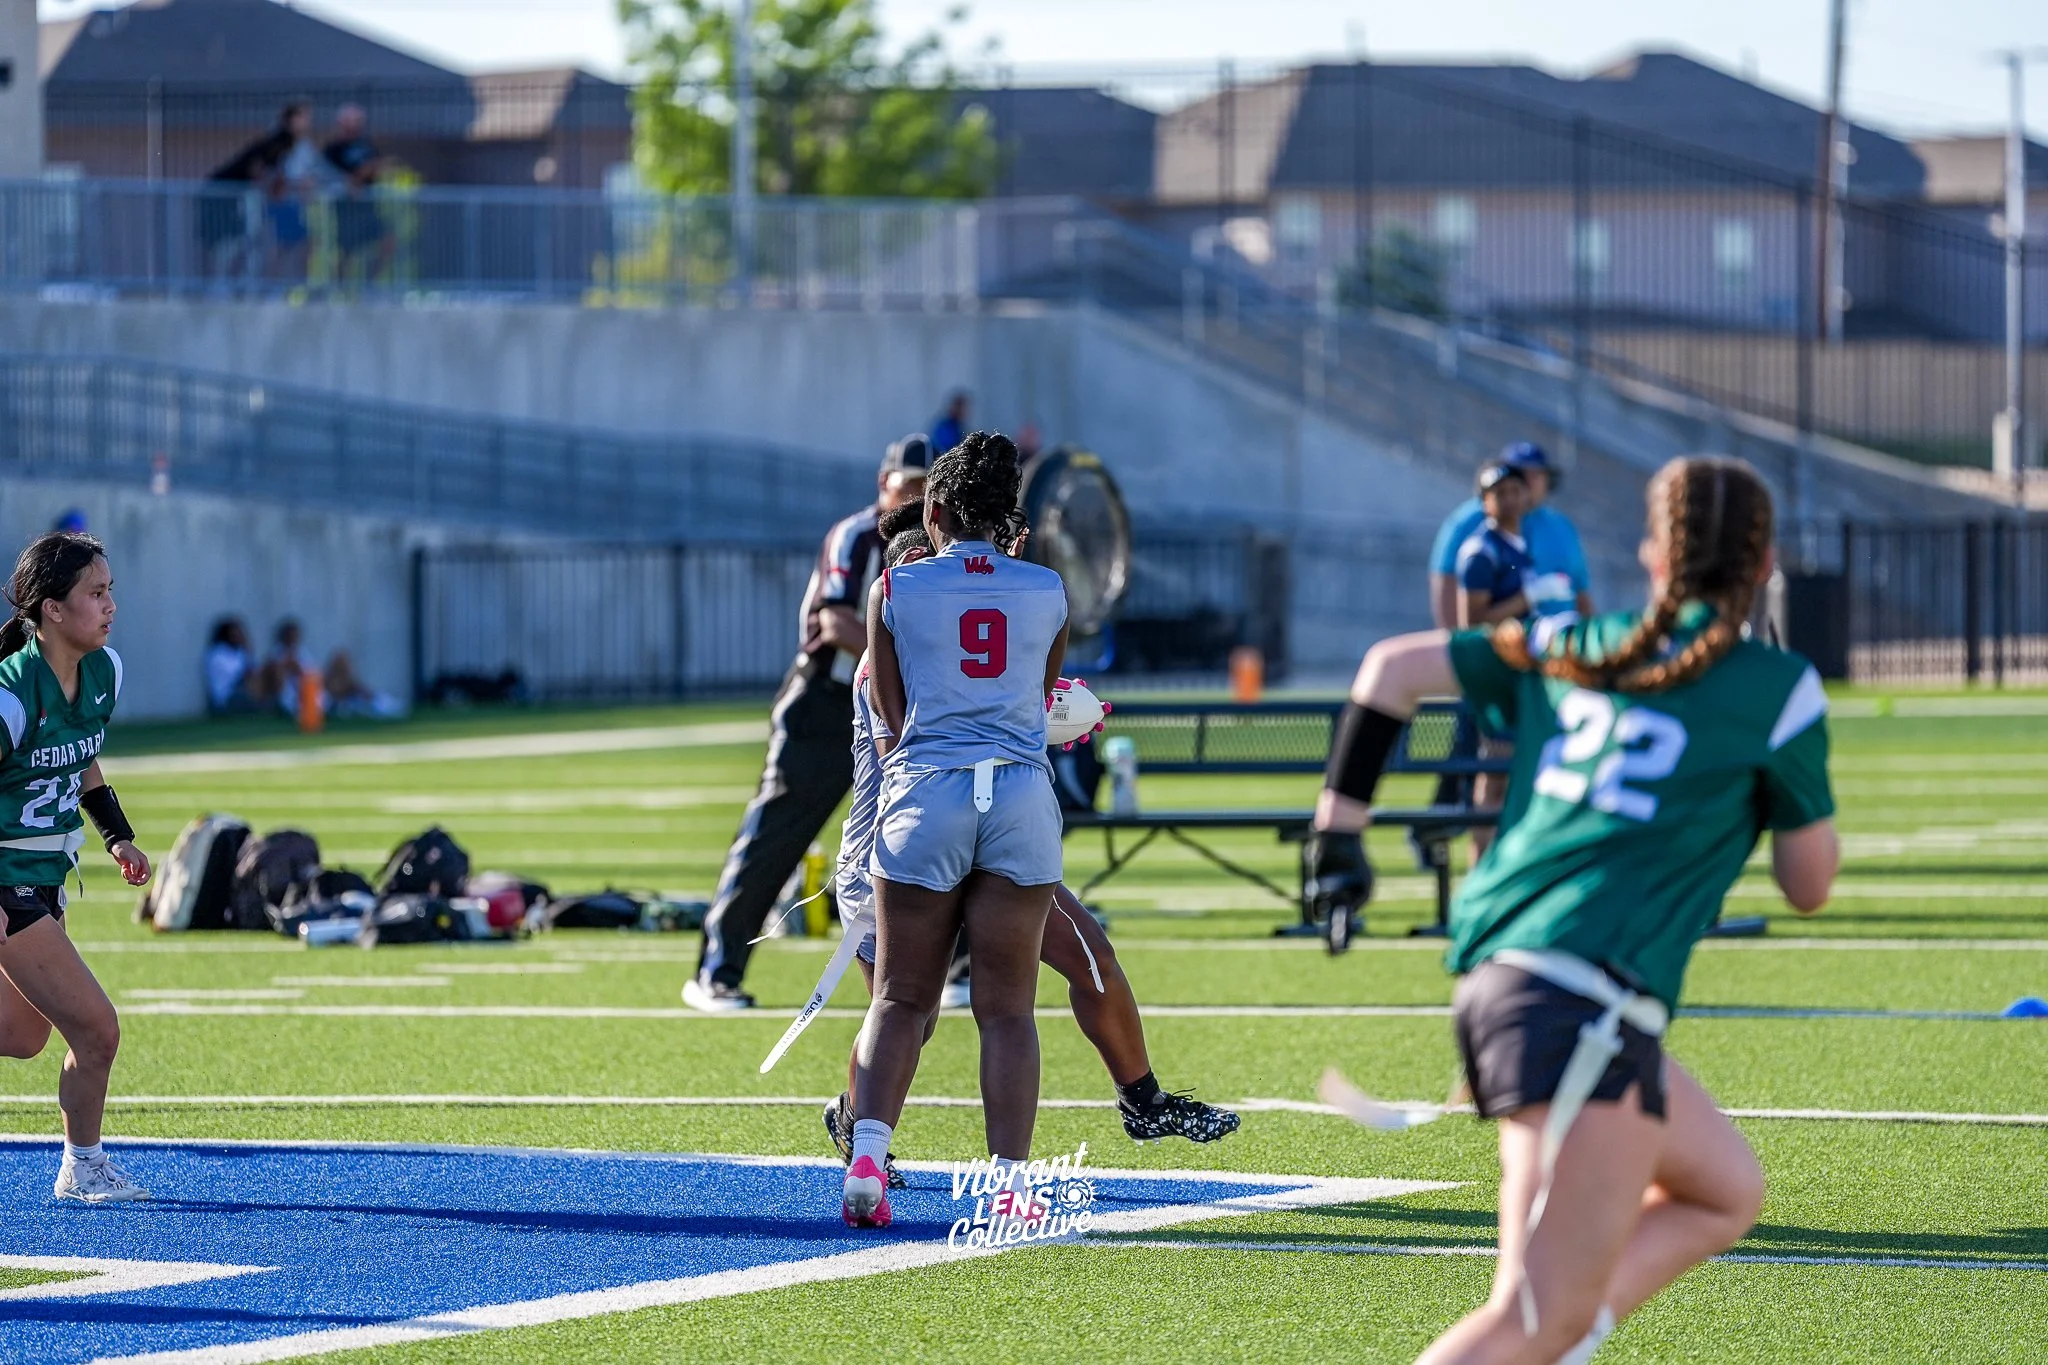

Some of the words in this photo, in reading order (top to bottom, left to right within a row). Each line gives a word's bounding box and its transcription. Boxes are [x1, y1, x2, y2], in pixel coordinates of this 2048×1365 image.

[959, 608, 1008, 678] 9
[31, 742, 77, 769] CEDAR
[1534, 687, 1689, 823] 22
[20, 768, 88, 829] 24
